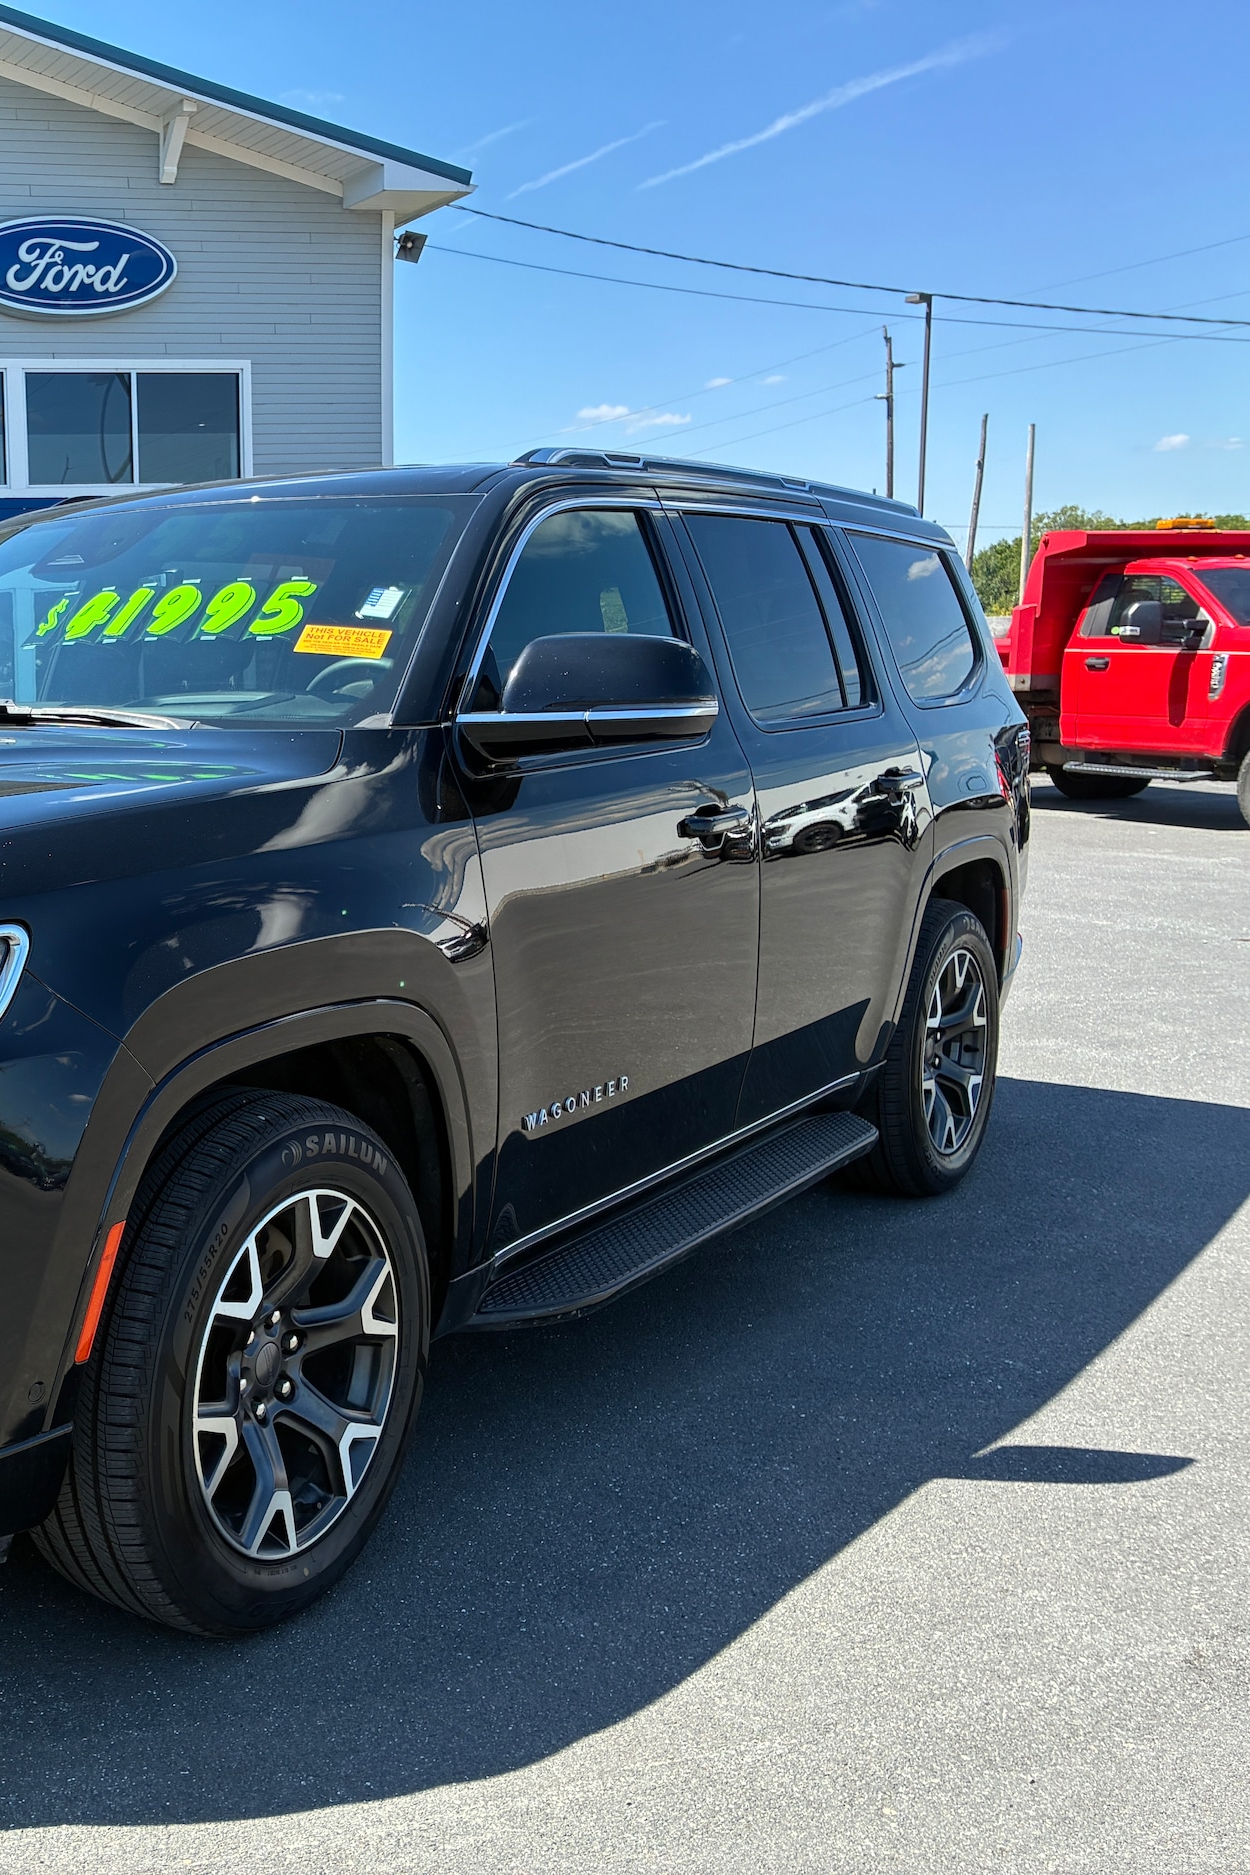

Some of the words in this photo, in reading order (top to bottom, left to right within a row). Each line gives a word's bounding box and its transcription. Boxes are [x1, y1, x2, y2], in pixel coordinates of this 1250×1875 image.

[6, 237, 130, 292] Ford
[35, 581, 317, 641] $41995
[309, 626, 334, 635] THIS
[337, 628, 387, 639] VEHICLE
[326, 634, 351, 642] FOR
[353, 636, 385, 645] SALE
[521, 1075, 629, 1132] WAGONEER
[305, 1132, 388, 1176] SAILUN
[184, 1222, 228, 1324] 275/55R20
